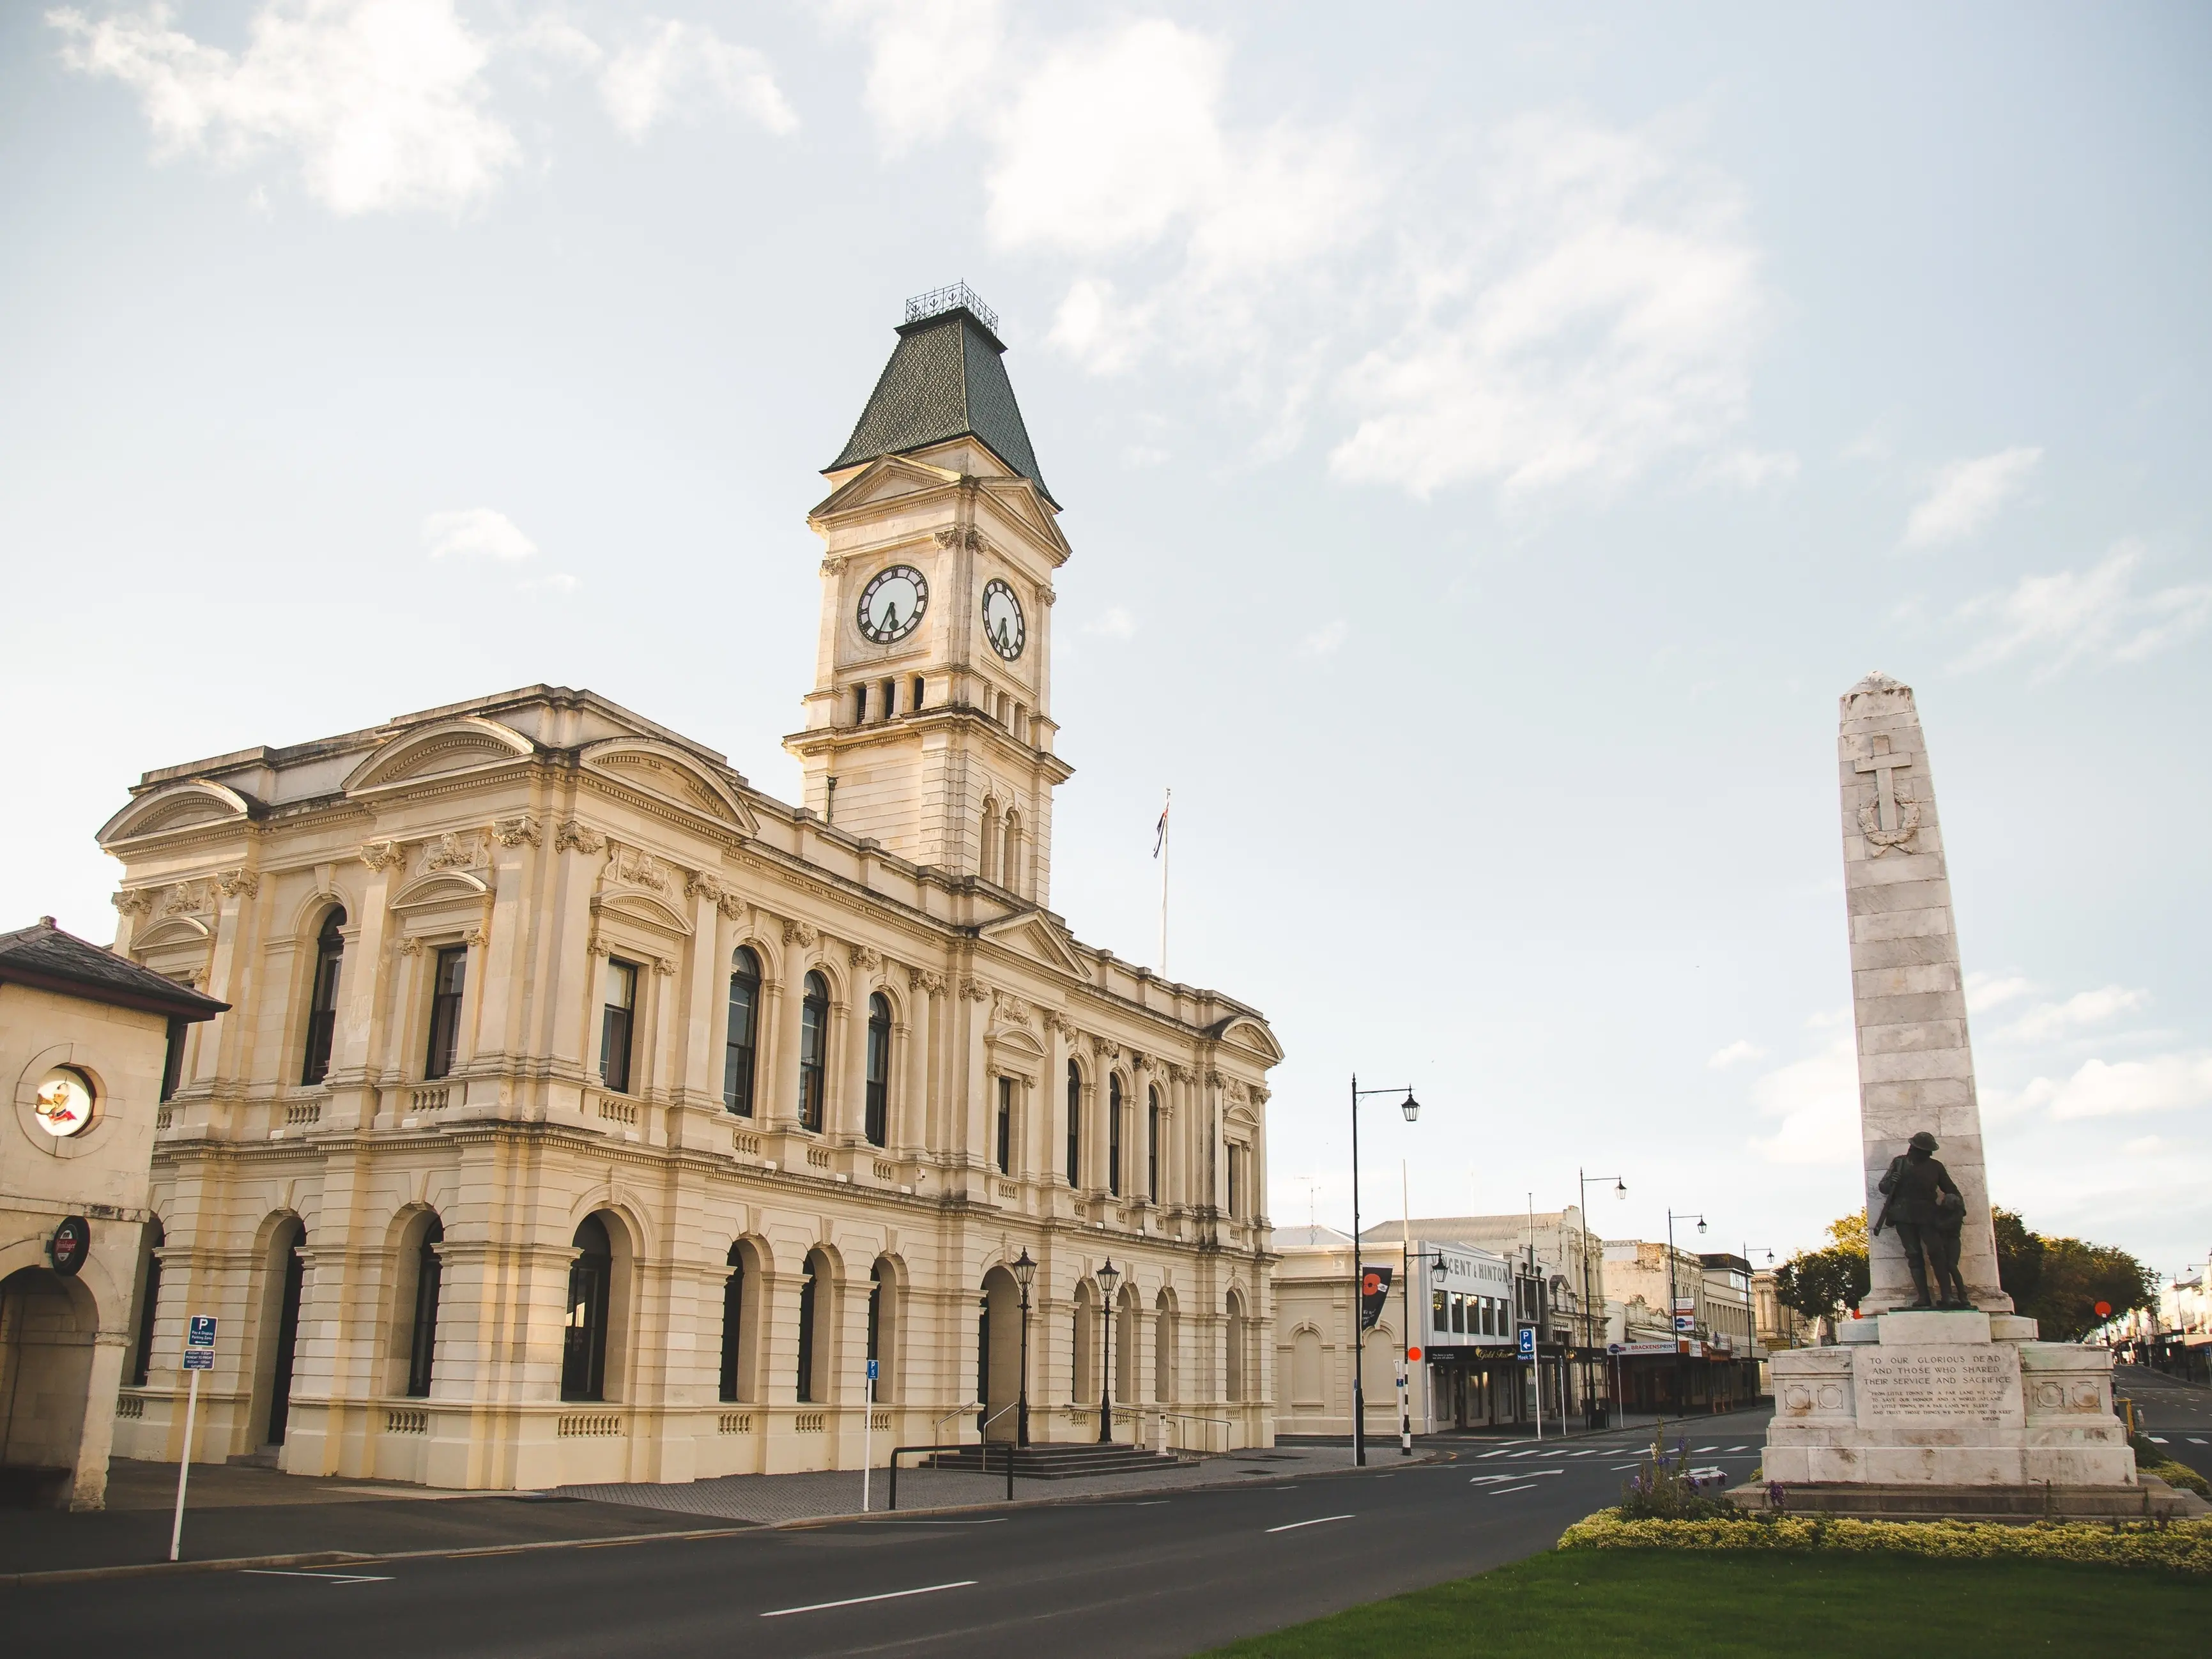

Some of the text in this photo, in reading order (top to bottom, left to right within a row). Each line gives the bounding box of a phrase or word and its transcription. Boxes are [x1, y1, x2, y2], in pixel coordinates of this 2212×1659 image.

[1431, 1255, 1471, 1277] VNCENT
[1479, 1264, 1508, 1283] HINTON
[199, 1319, 208, 1330] P
[1523, 1331, 1529, 1340] P
